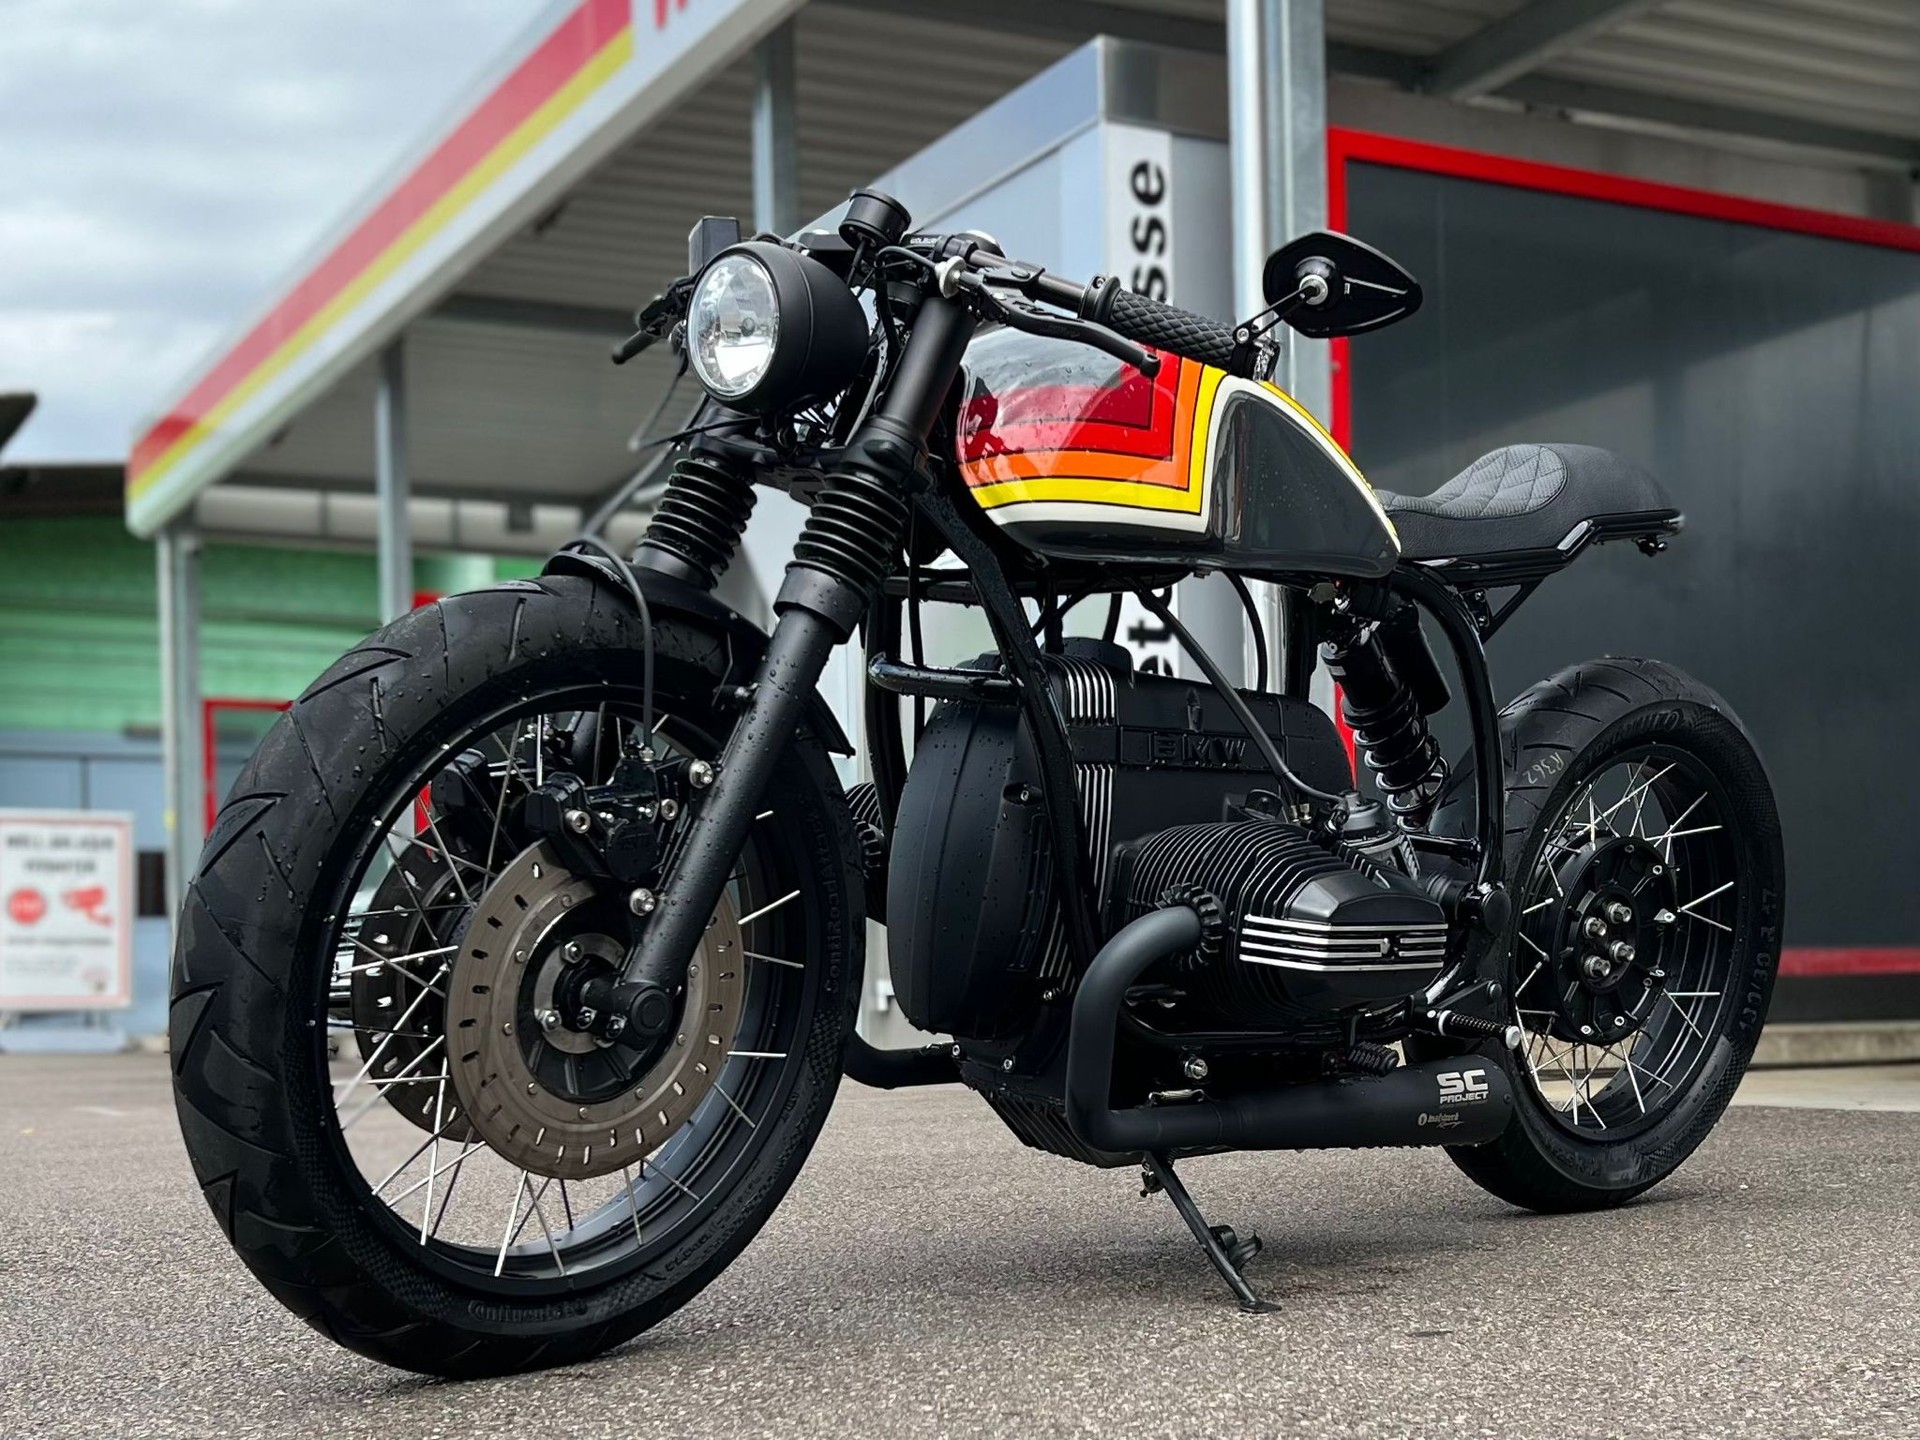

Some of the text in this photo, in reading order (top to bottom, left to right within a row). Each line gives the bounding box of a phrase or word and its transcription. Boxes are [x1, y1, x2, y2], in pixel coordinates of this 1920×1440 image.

[1130, 160, 1168, 304] sse
[1152, 731, 1247, 764] BMW
[1436, 1069, 1489, 1095] SC
[1440, 1091, 1490, 1105] PROJECT
